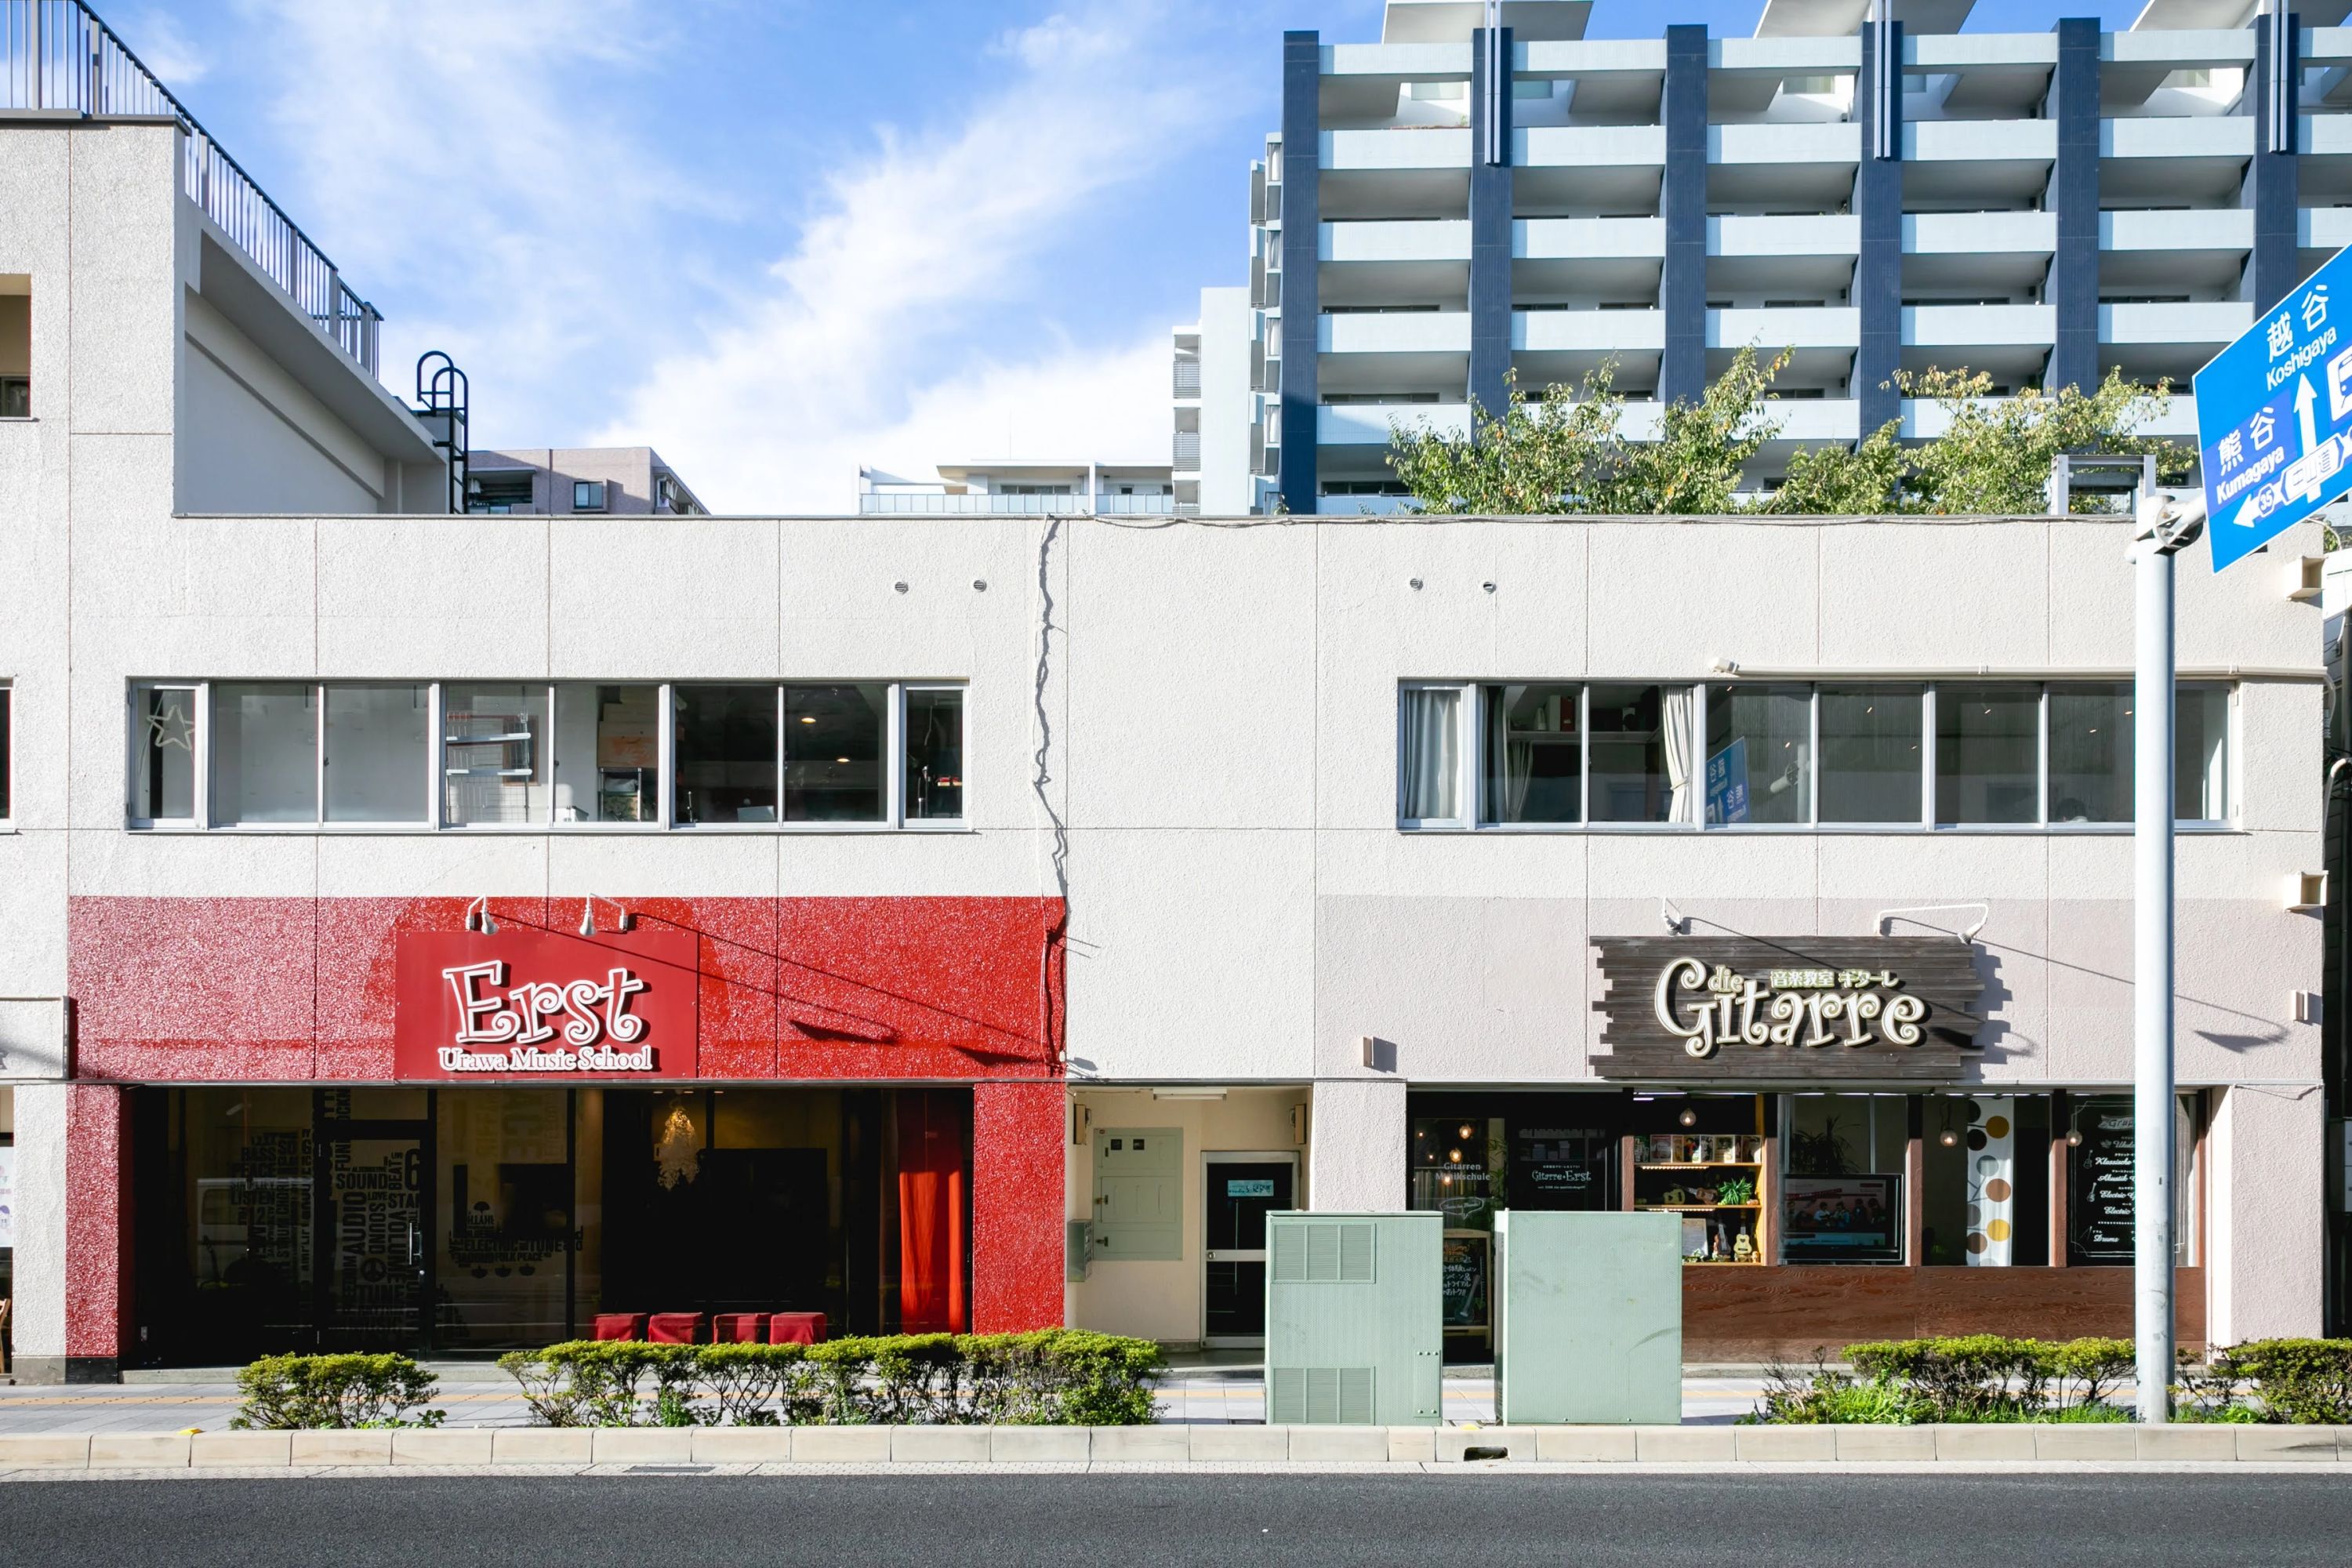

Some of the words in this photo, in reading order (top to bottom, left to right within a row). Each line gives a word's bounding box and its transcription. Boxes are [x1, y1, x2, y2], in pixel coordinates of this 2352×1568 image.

[2267, 285, 2329, 364] 越谷
[2266, 326, 2337, 392] Koshigaya
[2218, 406, 2275, 477] 熊谷
[2216, 446, 2285, 505] Kumagaya
[2259, 489, 2273, 510] 35
[1708, 965, 1744, 993] die
[1770, 970, 1835, 989] 音楽教室
[442, 960, 644, 1045] Erst
[1655, 956, 1926, 1058] Gitarre
[438, 1047, 510, 1072] Urawa
[510, 1047, 577, 1072] Music
[578, 1045, 652, 1071] School
[336, 1172, 389, 1189] SOUND
[388, 1160, 402, 1190] BEAT
[1443, 1162, 1481, 1171] Gitarren
[230, 1191, 275, 1205] LISTEN
[368, 1192, 388, 1200] LOVE
[343, 1192, 367, 1256] AUDIO
[368, 1203, 387, 1254] SOUND
[2092, 1234, 2120, 1243] Drums
[388, 1210, 407, 1284] VOLUME
